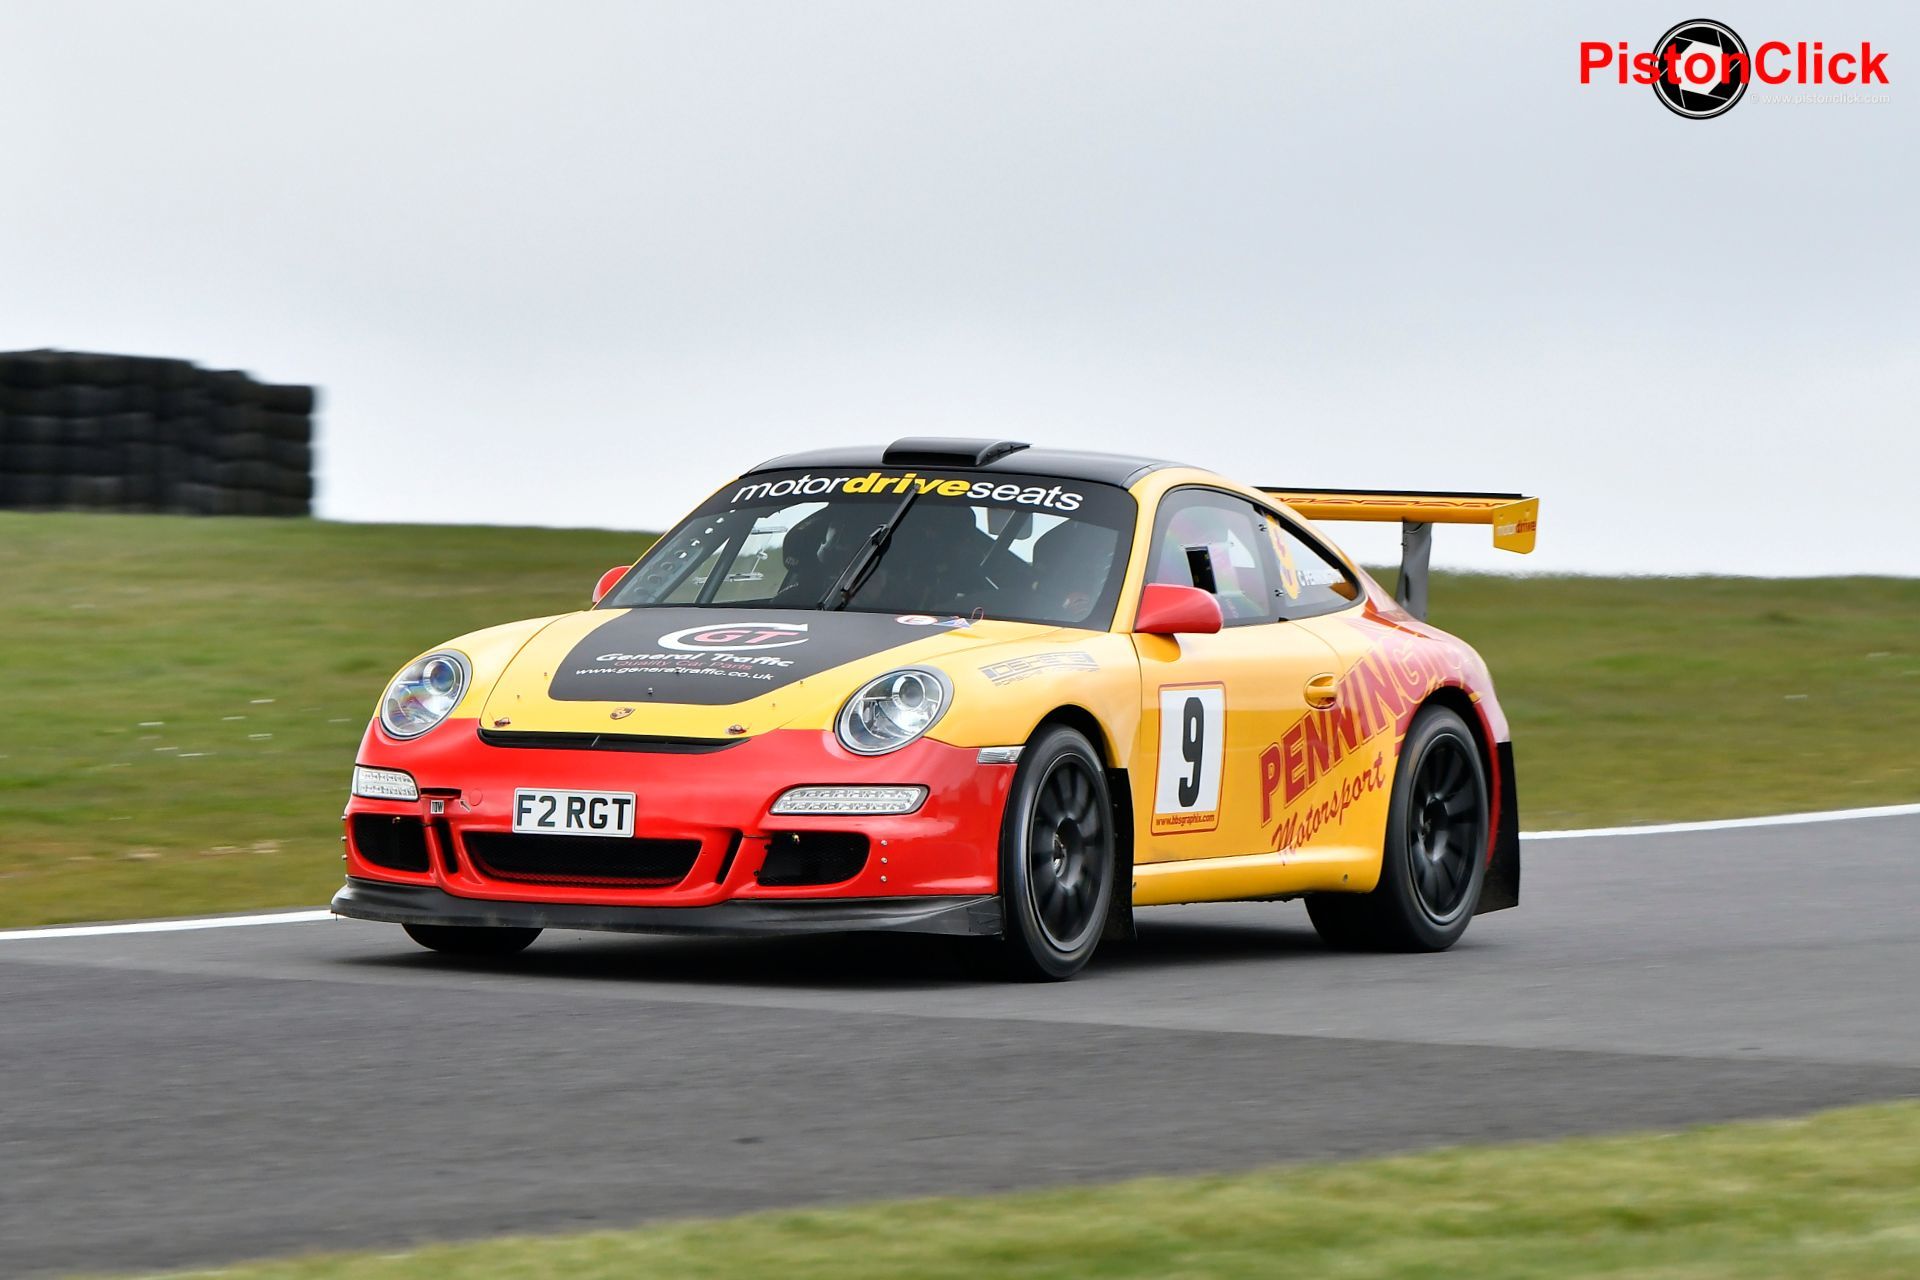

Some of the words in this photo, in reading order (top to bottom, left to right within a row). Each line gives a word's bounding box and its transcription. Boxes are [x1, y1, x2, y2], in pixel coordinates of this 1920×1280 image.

[596, 651, 706, 662] General
[710, 652, 796, 669] Traffic
[614, 660, 668, 668] Quality
[676, 660, 705, 668] Car
[710, 661, 753, 670] Parts
[1179, 697, 1205, 807] 9
[517, 795, 556, 827] F2
[566, 797, 631, 830] RGT
[1271, 751, 1386, 865] Motorsport
